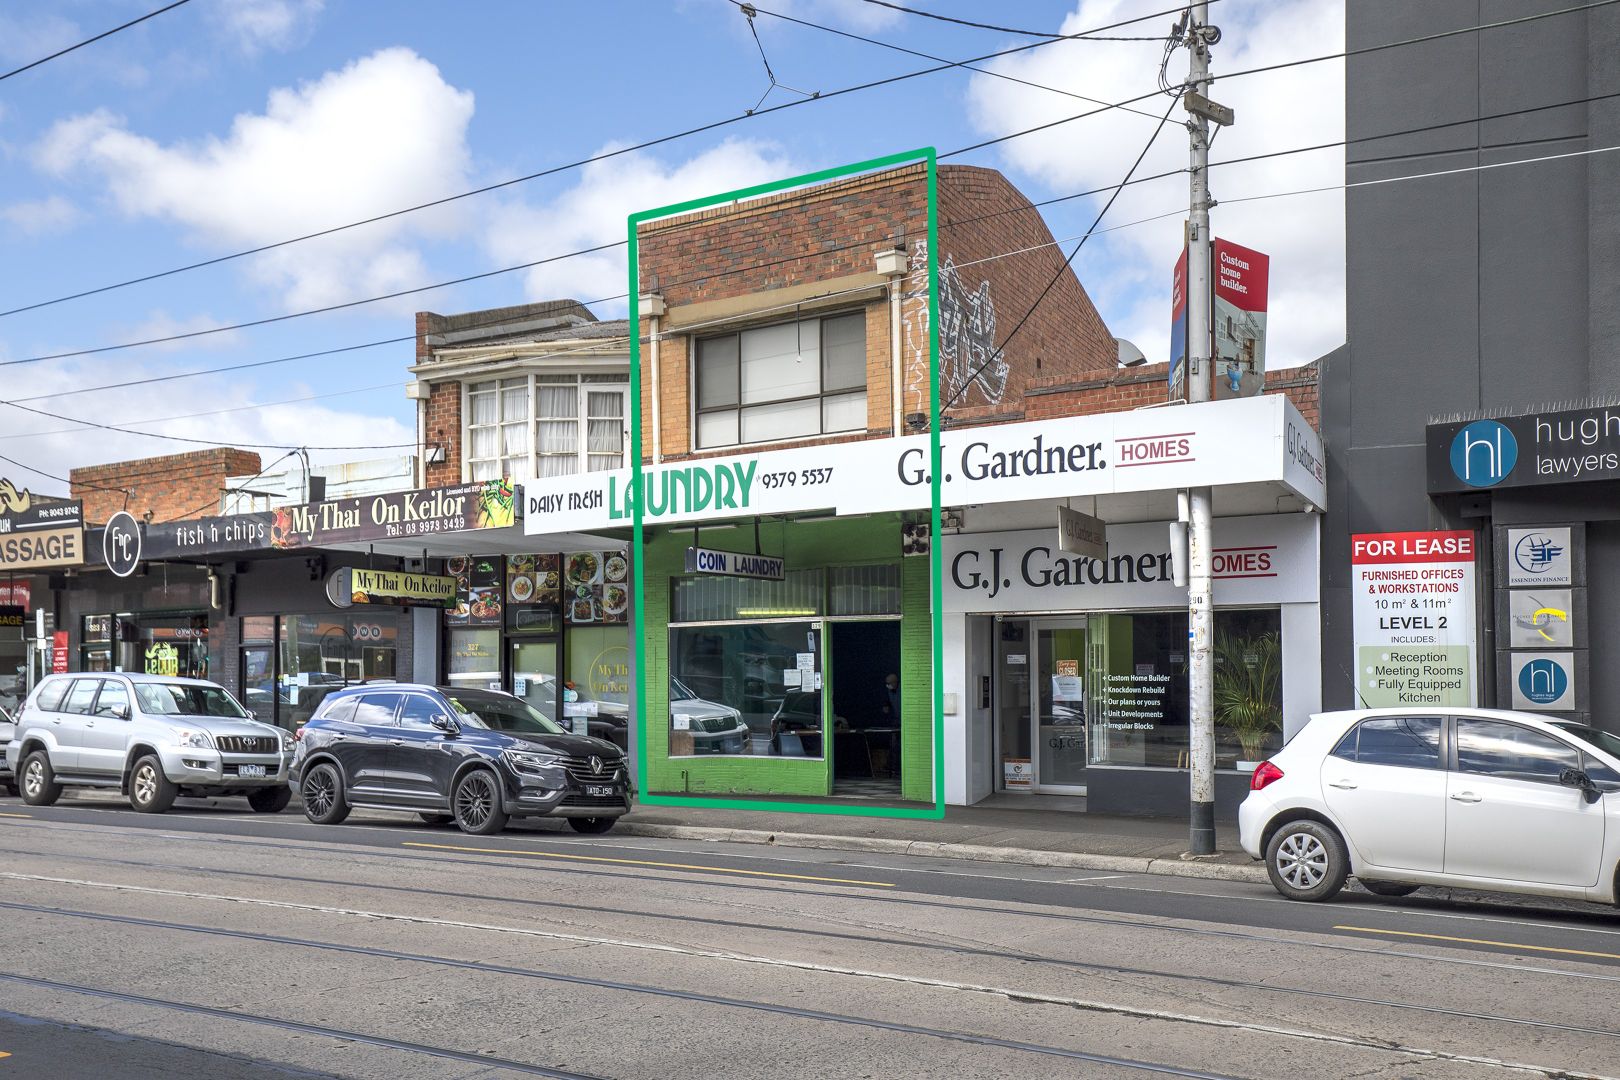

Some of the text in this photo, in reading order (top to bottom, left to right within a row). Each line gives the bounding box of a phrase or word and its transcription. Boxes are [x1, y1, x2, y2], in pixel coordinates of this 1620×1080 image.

[1220, 251, 1249, 271] Custom
[1221, 264, 1241, 279] home
[1221, 276, 1248, 294] builder.
[961, 434, 1106, 481] Gardner.
[1121, 439, 1190, 461] HOMES
[1465, 427, 1501, 479] hl
[1537, 453, 1618, 477] lawyers
[530, 460, 834, 520] DAISY FRESH LAUNDRY 9379 5537
[290, 490, 466, 541] My Thai On Keilor
[176, 525, 204, 546] fish
[225, 520, 264, 544] chips
[386, 524, 403, 536] Tel:
[406, 523, 416, 534] 03
[1354, 537, 1471, 557] FOR LEASE
[698, 552, 782, 577] COIN LAUNDRY
[951, 548, 1011, 598] G.J.
[1212, 552, 1271, 573] OMES
[1362, 569, 1464, 581] FURNISHED OFFICES
[357, 572, 374, 594] My
[374, 573, 399, 591] Thai
[404, 575, 420, 591] On
[421, 578, 452, 594] Keilor
[1369, 583, 1459, 594] & WORKSTATIONS
[1375, 599, 1389, 609] 10
[1411, 599, 1419, 609] &
[1380, 616, 1448, 630] LEVEL 2
[1391, 636, 1437, 644] INCLUDES:
[1391, 652, 1447, 664] Reception
[1107, 674, 1129, 682] Custom
[1375, 665, 1464, 678] Meeting Rooms
[1531, 663, 1555, 693] hl
[1378, 679, 1461, 691] Fully Equipped
[1119, 699, 1136, 707] plans
[1399, 693, 1441, 702] Kitchen
[1121, 711, 1163, 719] Developments
